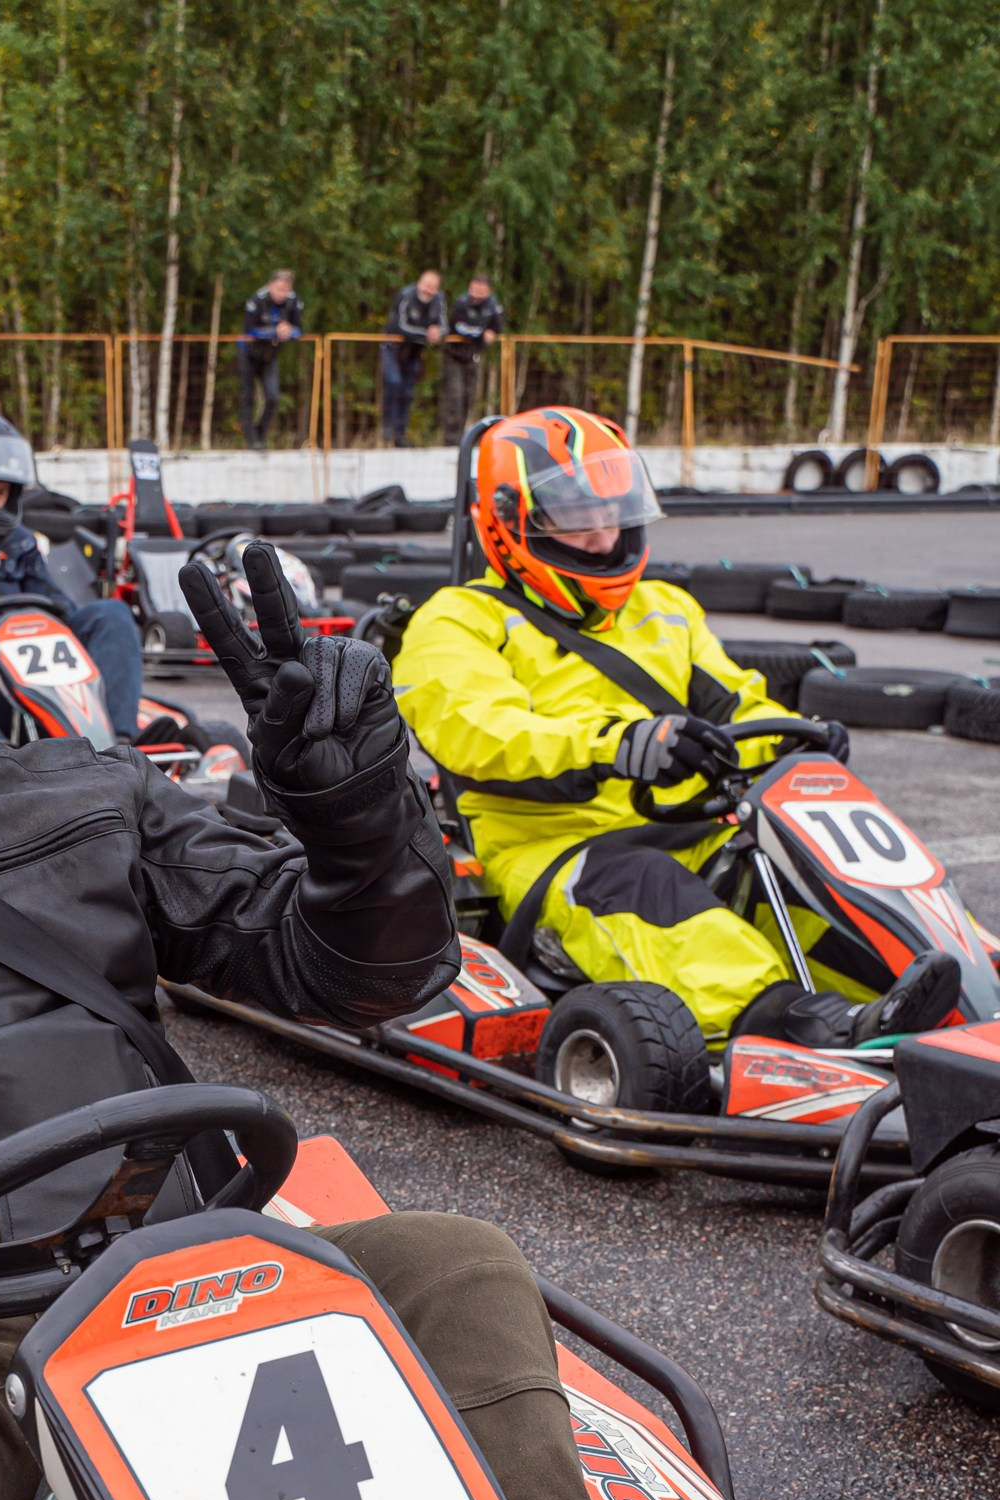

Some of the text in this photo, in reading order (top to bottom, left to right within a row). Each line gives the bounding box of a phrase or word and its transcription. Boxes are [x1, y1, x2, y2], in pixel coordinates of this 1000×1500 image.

[18, 641, 77, 675] 24
[805, 809, 907, 863] 10
[125, 1263, 282, 1325] DINO
[159, 1299, 240, 1328] KART
